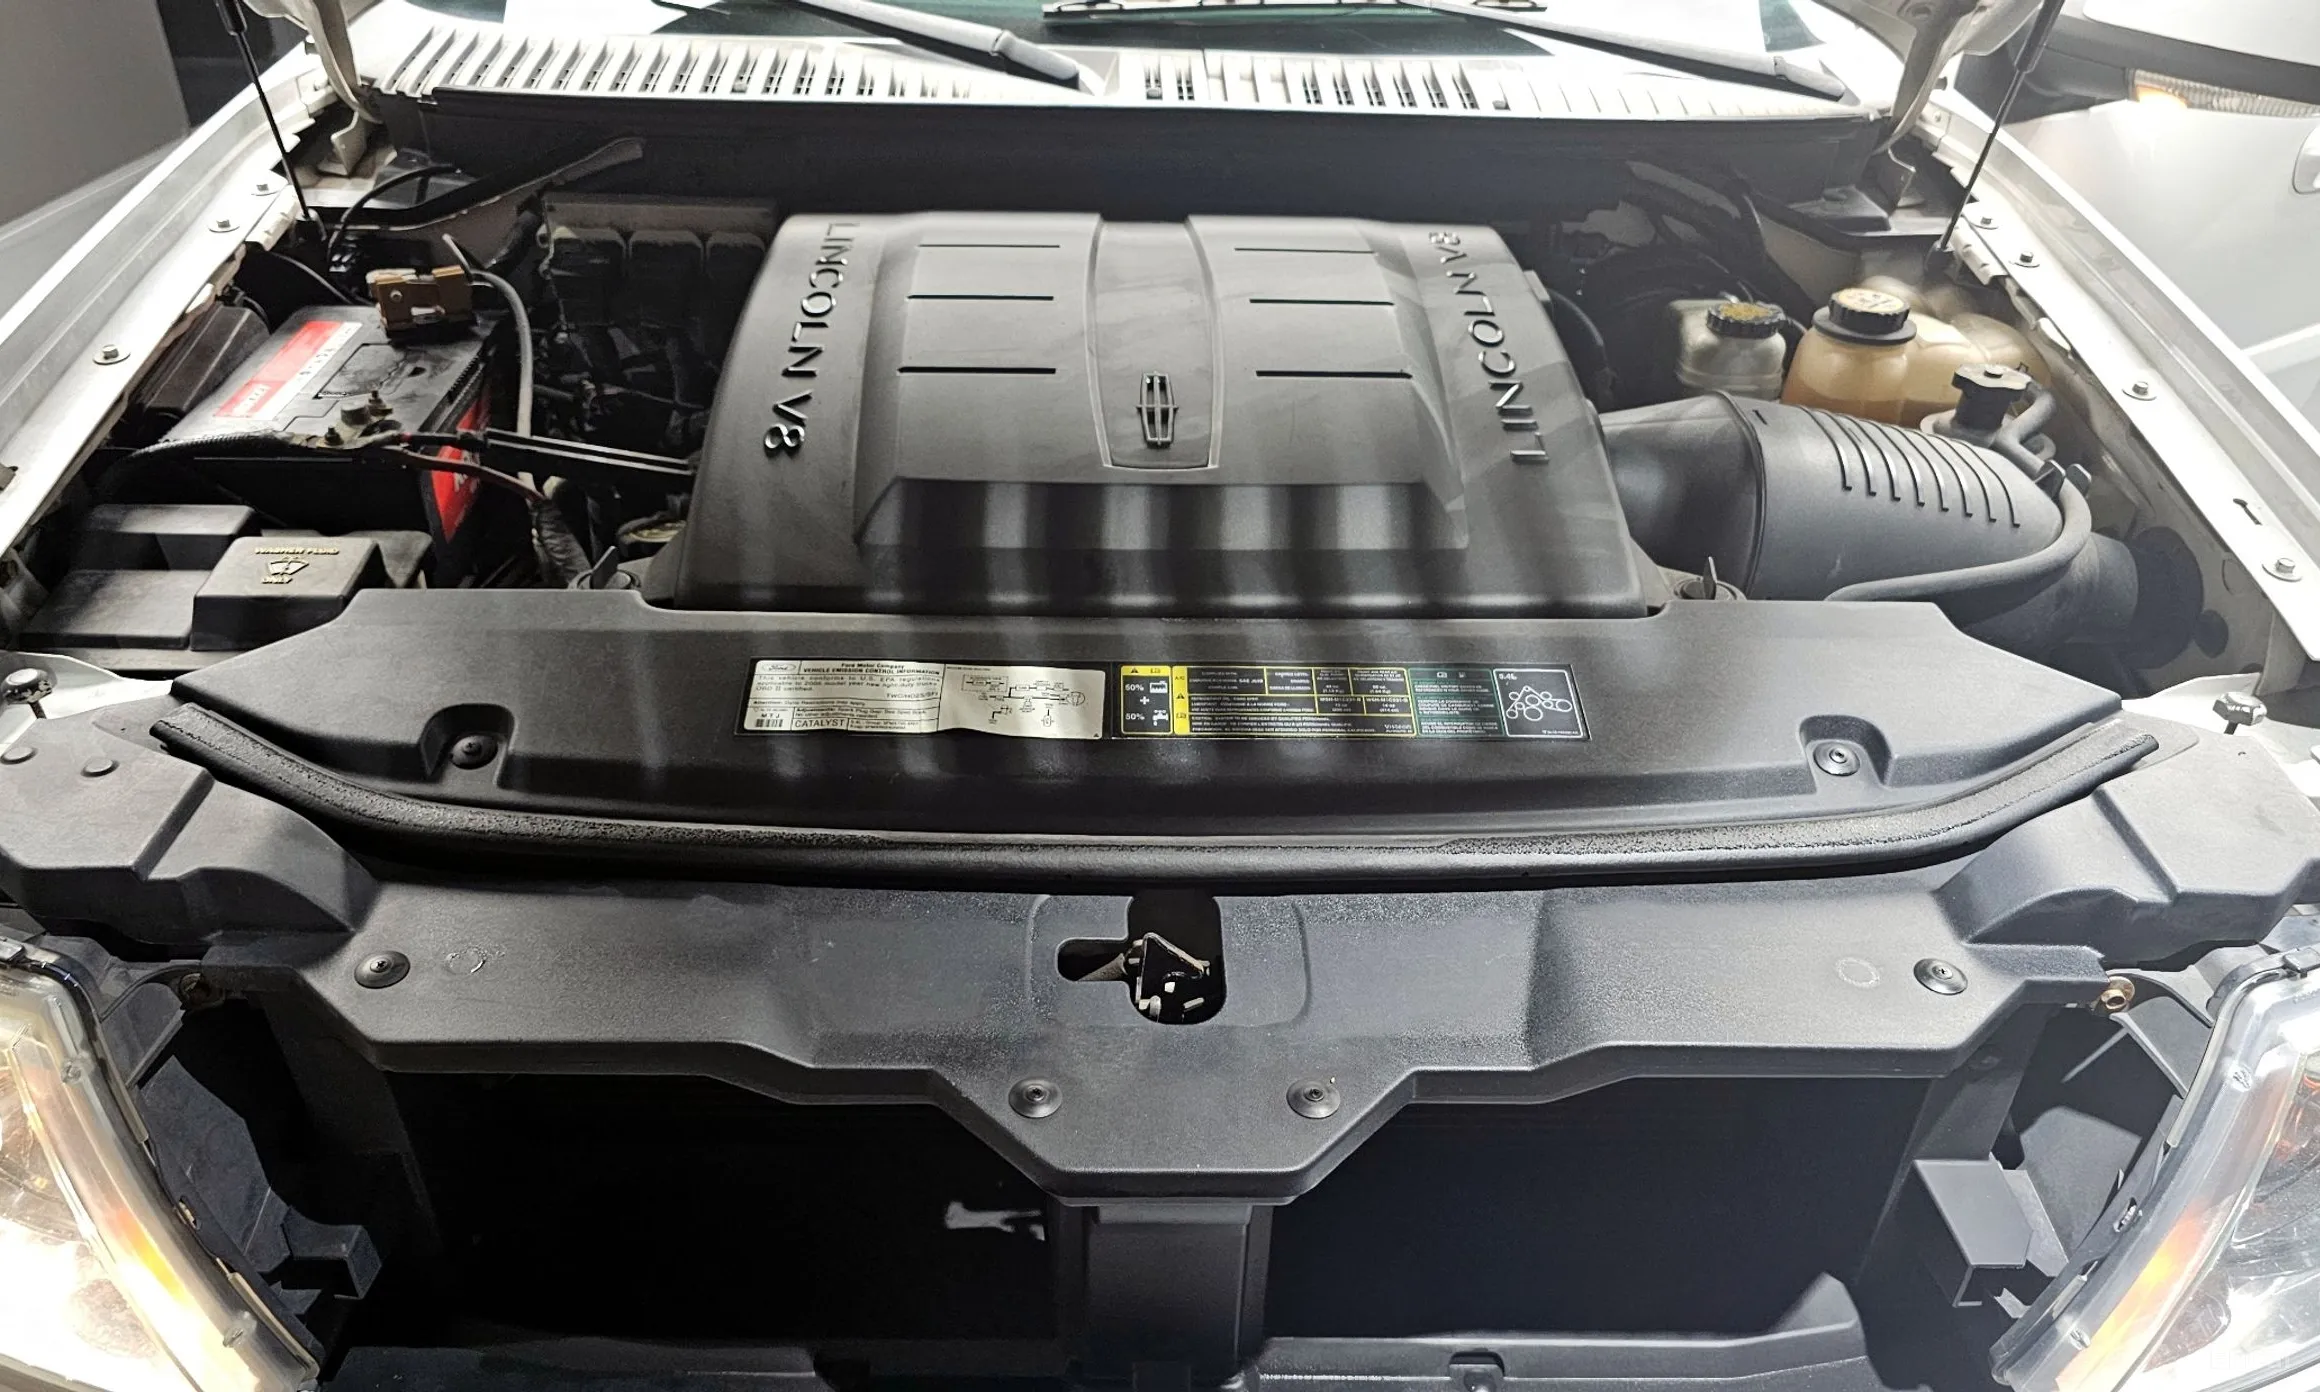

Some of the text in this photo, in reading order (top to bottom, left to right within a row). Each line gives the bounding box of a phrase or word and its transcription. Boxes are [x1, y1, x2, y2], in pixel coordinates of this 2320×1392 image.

[763, 222, 860, 458] LINCOLN V8
[1446, 270, 1549, 465] LINCOLN
[254, 546, 341, 556] WASHER FLUID
[261, 576, 293, 584] ONLY
[1125, 683, 1145, 691] 50%
[1125, 713, 1146, 721] 50%
[795, 719, 845, 728] CATALYST
